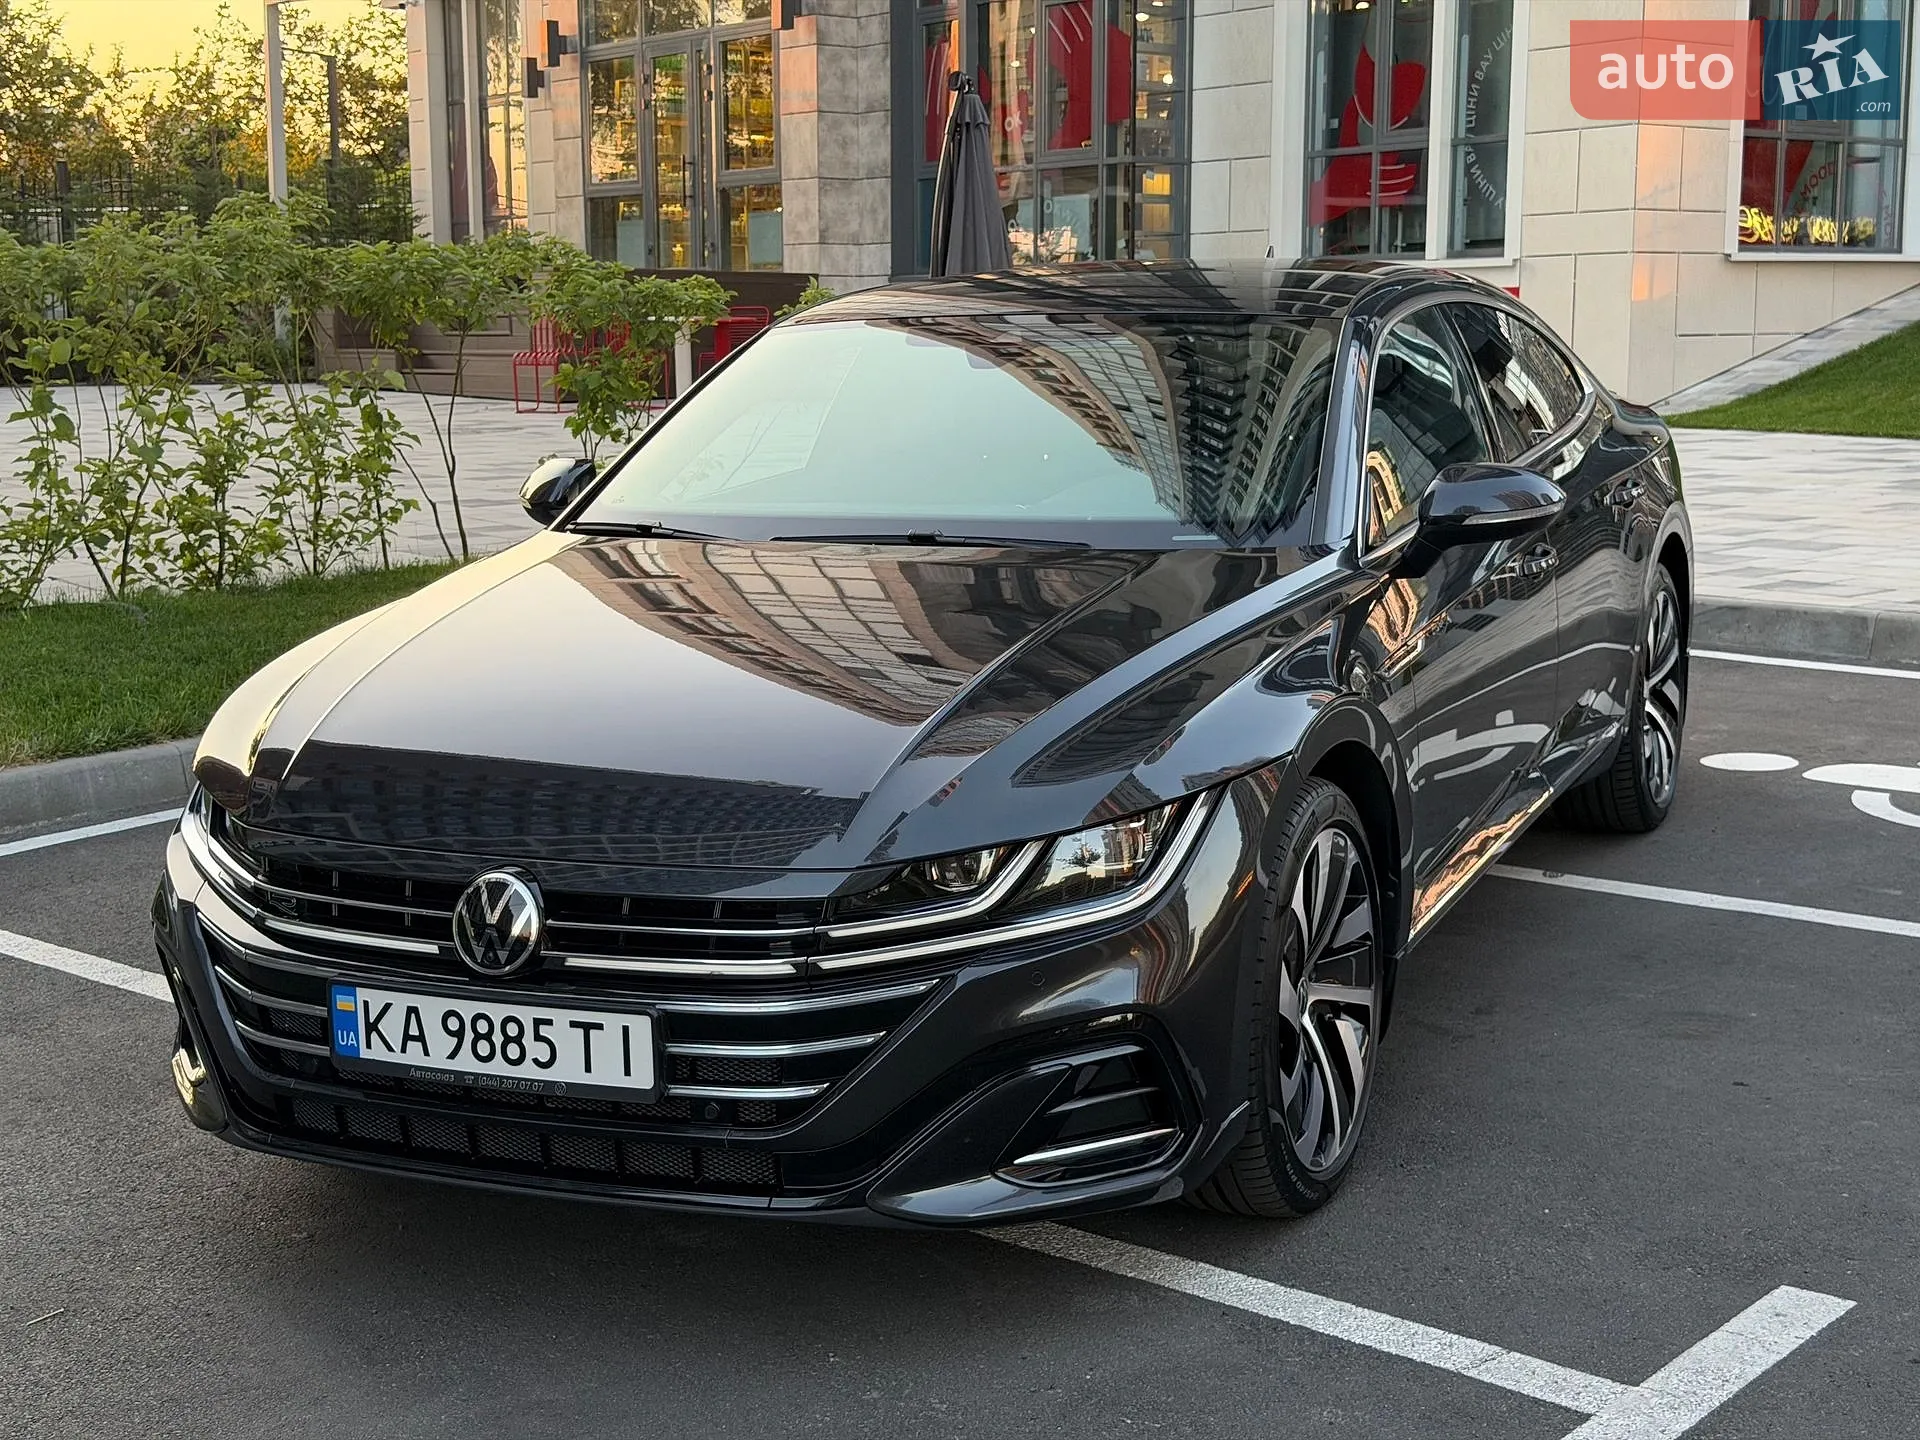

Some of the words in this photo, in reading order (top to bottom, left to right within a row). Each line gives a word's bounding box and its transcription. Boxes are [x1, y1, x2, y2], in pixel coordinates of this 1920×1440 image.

[1466, 83, 1481, 128] ЦІНИ
[338, 1030, 357, 1048] UA
[362, 999, 431, 1058] KA
[440, 1009, 558, 1070] 9885
[478, 1074, 500, 1088] (044)
[502, 1079, 518, 1089] 207
